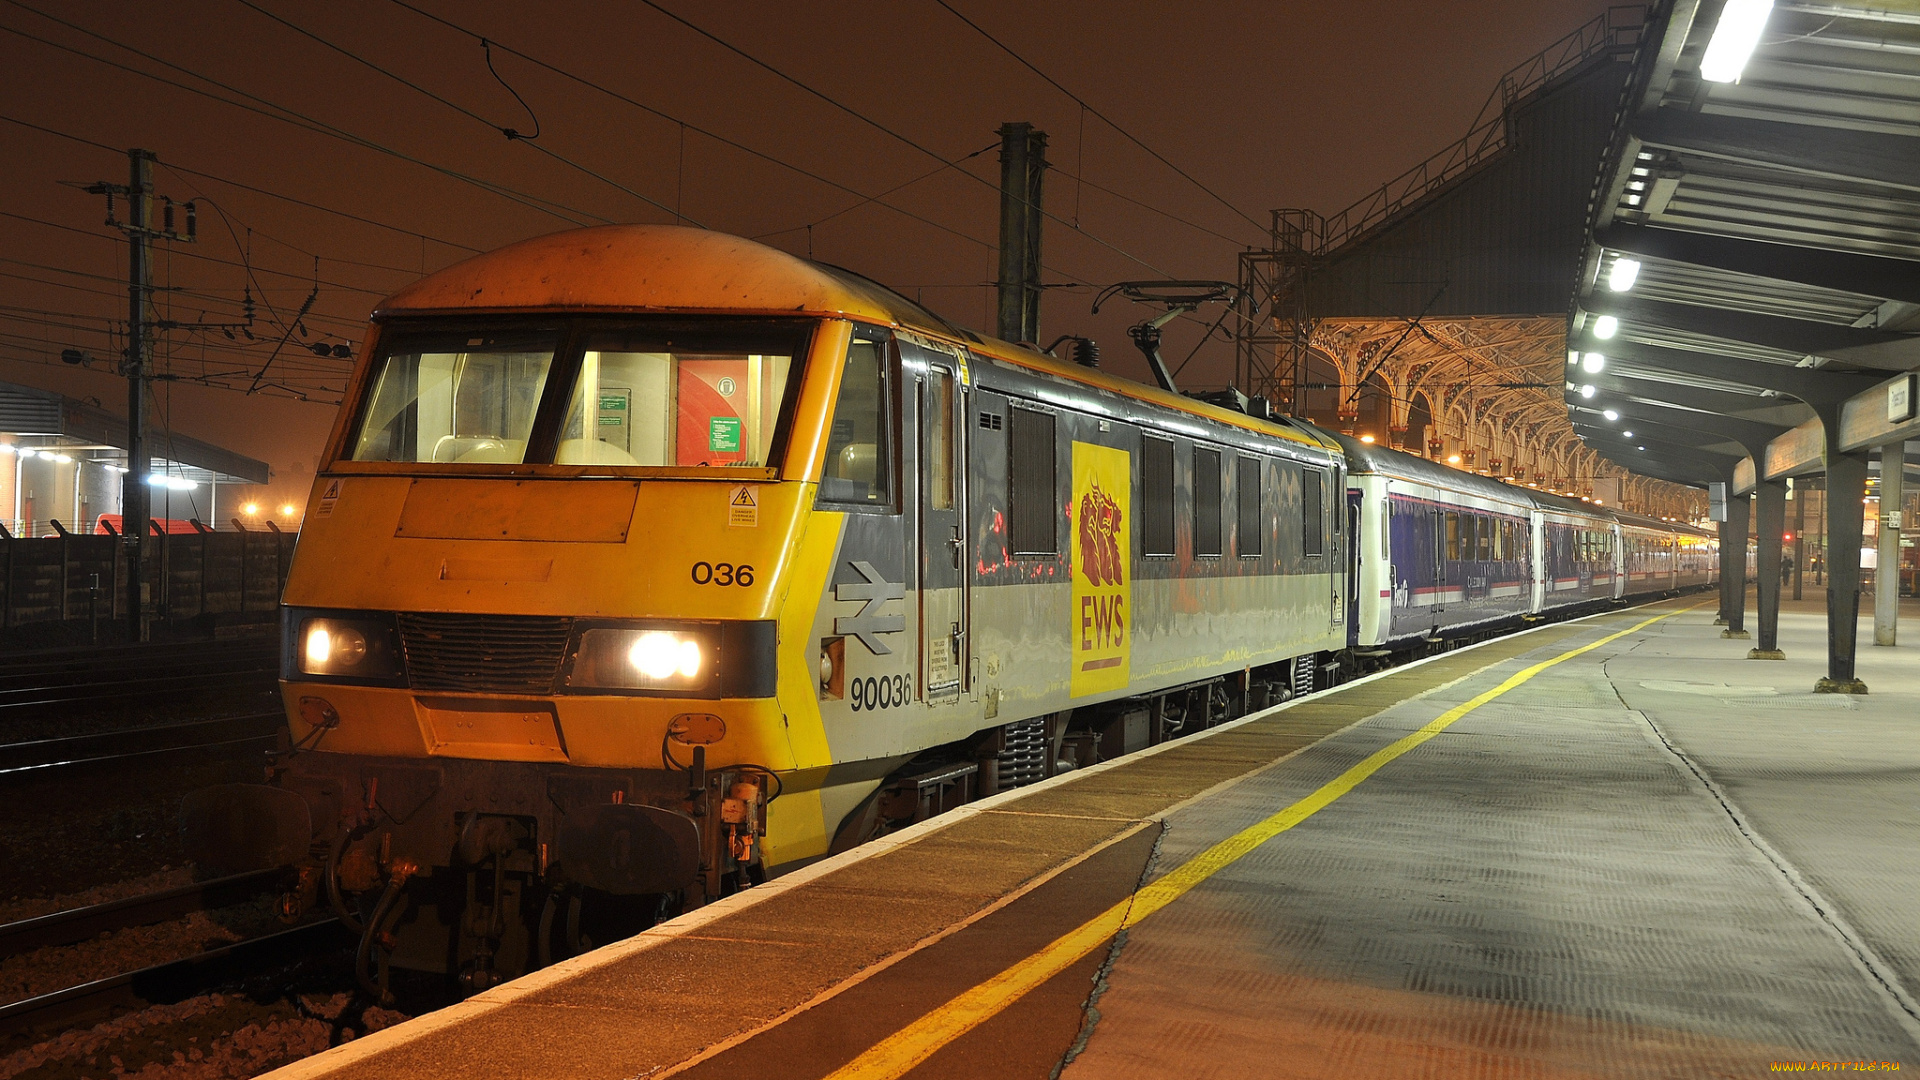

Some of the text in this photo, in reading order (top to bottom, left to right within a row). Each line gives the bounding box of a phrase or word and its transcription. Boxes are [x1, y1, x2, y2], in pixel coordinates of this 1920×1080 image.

[691, 561, 755, 587] 036
[1081, 594, 1124, 651] EWS
[850, 672, 912, 712] 90036
